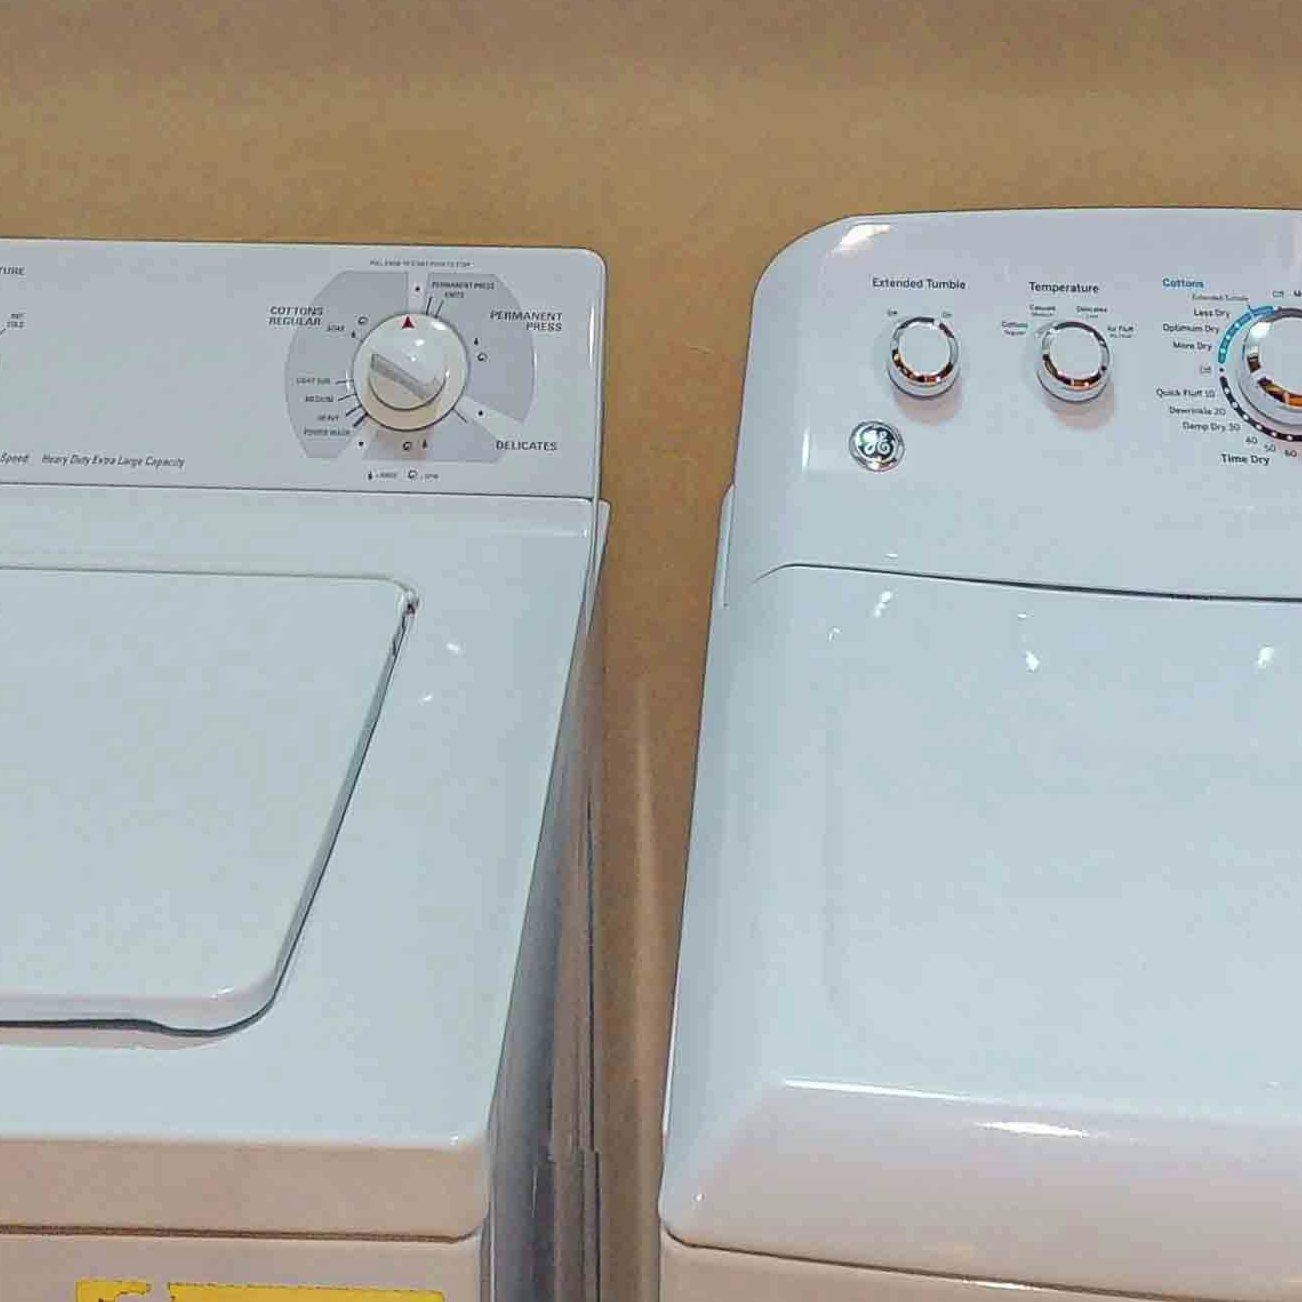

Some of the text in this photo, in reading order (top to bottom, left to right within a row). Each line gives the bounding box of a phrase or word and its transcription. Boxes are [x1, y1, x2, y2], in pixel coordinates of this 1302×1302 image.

[872, 277, 966, 290] Extended Tumble
[1029, 281, 1099, 295] Temperature
[1162, 278, 1204, 289] Cottons
[270, 305, 323, 316] COTTONS
[490, 310, 563, 322] PERMANENT
[1194, 308, 1230, 319] Less Dry
[268, 316, 323, 326] REGULAR
[526, 321, 563, 331] PRESS
[1162, 323, 1219, 334] Optimum Dry
[1173, 341, 1212, 351] More Dry
[1169, 406, 1226, 416] Dewrinkle 20
[1182, 421, 1208, 432] Damp
[1210, 422, 1226, 432] Dry
[496, 440, 558, 452] DELICATES
[1245, 436, 1258, 444] 40
[1264, 444, 1276, 452] 50
[1285, 449, 1297, 458] 60
[1, 452, 29, 465] Speed
[42, 453, 67, 466] Heavy
[69, 454, 90, 466] Duty
[117, 455, 143, 468] Large
[145, 456, 185, 469] Capacity
[1221, 453, 1270, 466] Time Dry
